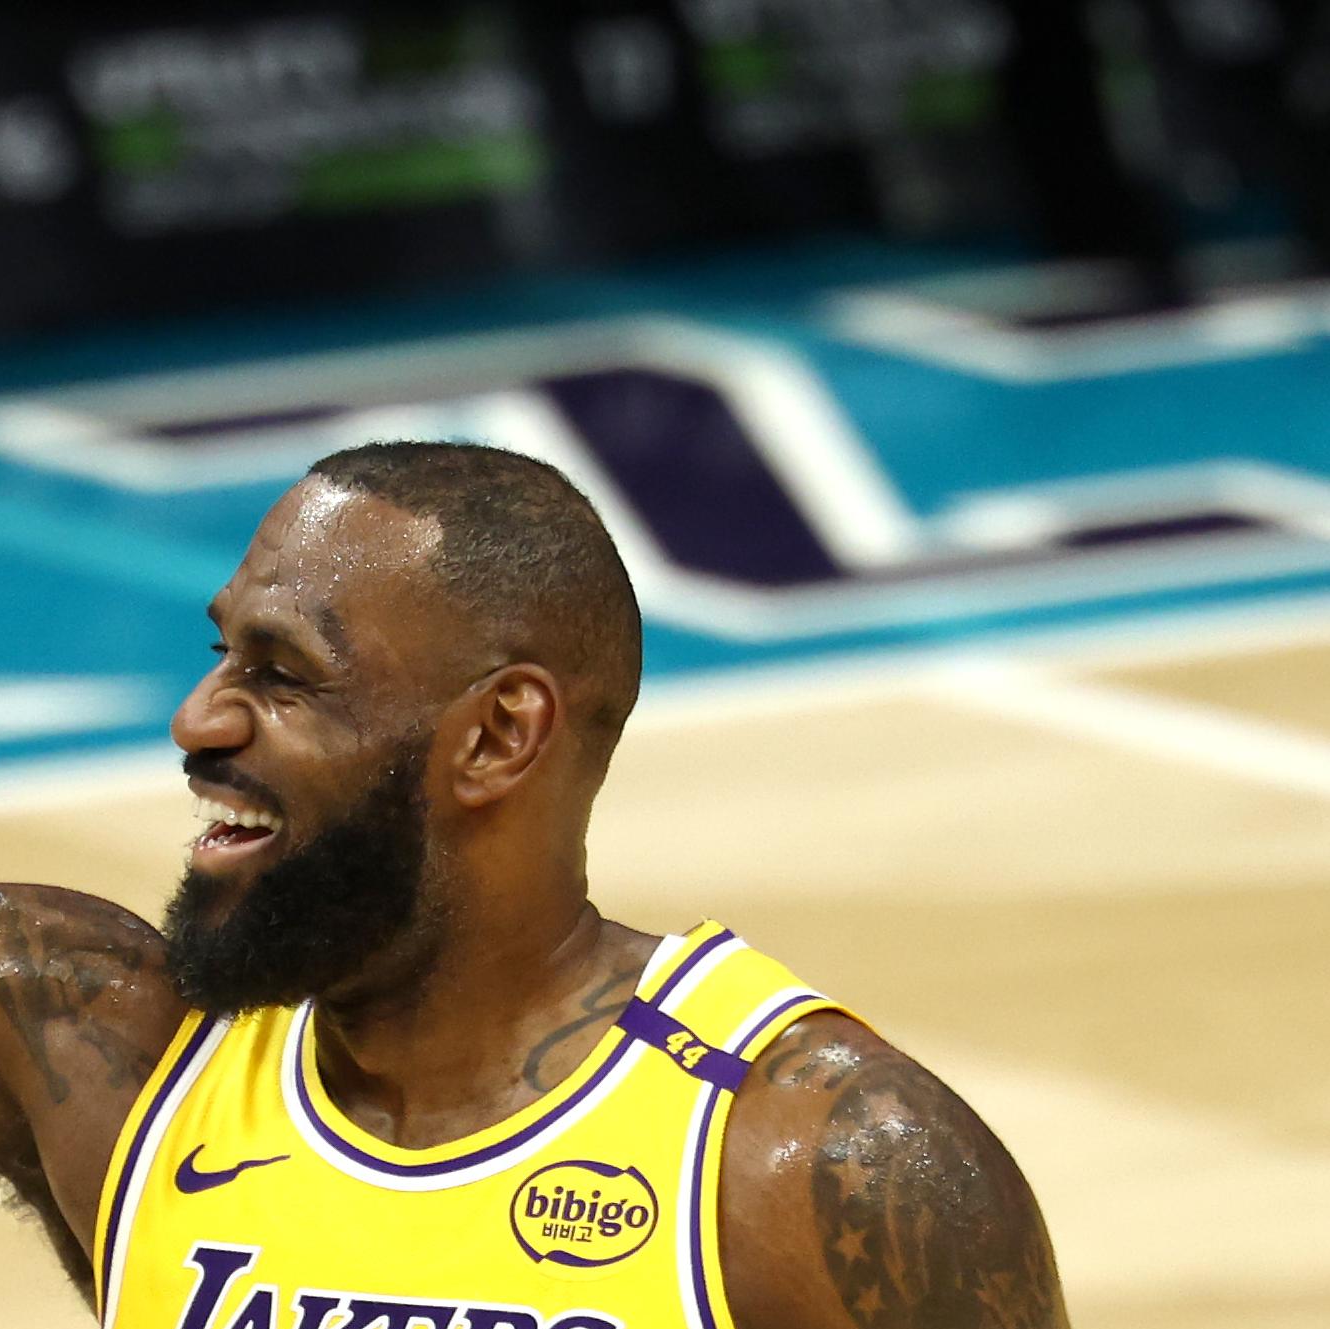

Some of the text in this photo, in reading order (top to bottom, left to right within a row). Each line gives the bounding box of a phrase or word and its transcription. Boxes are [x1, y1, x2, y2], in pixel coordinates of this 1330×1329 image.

[666, 1031, 710, 1070] 44
[525, 1186, 649, 1237] bibigo
[542, 1222, 593, 1243] 비비고
